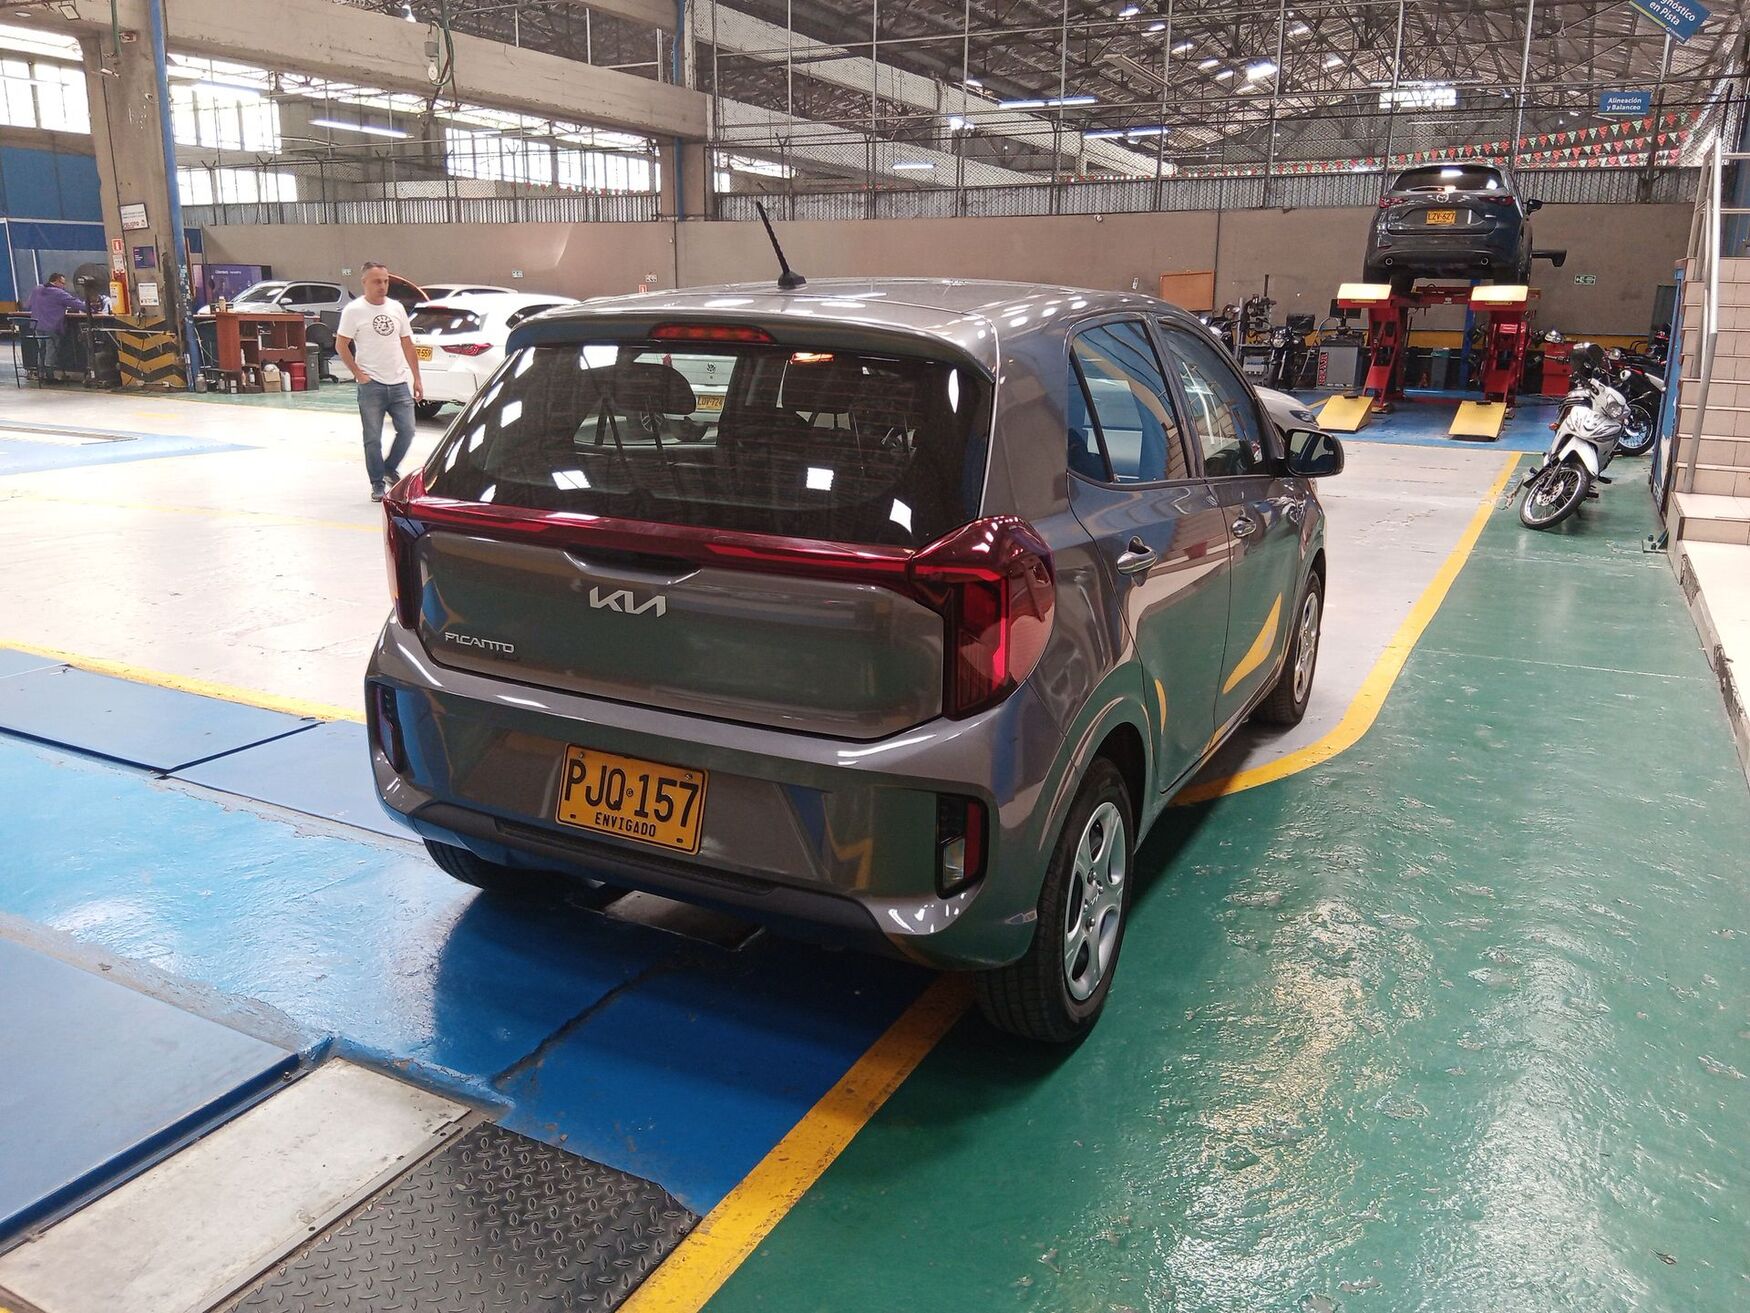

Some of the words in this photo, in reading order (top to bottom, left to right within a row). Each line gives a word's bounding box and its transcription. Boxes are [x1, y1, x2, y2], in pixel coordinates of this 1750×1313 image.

[1649, 1, 1661, 12] en
[1660, 7, 1680, 25] Pista
[1660, 0, 1696, 22] gnóstico
[589, 586, 666, 618] KIA
[445, 631, 515, 654] PICANTO
[594, 811, 657, 838] ENVIGADO
